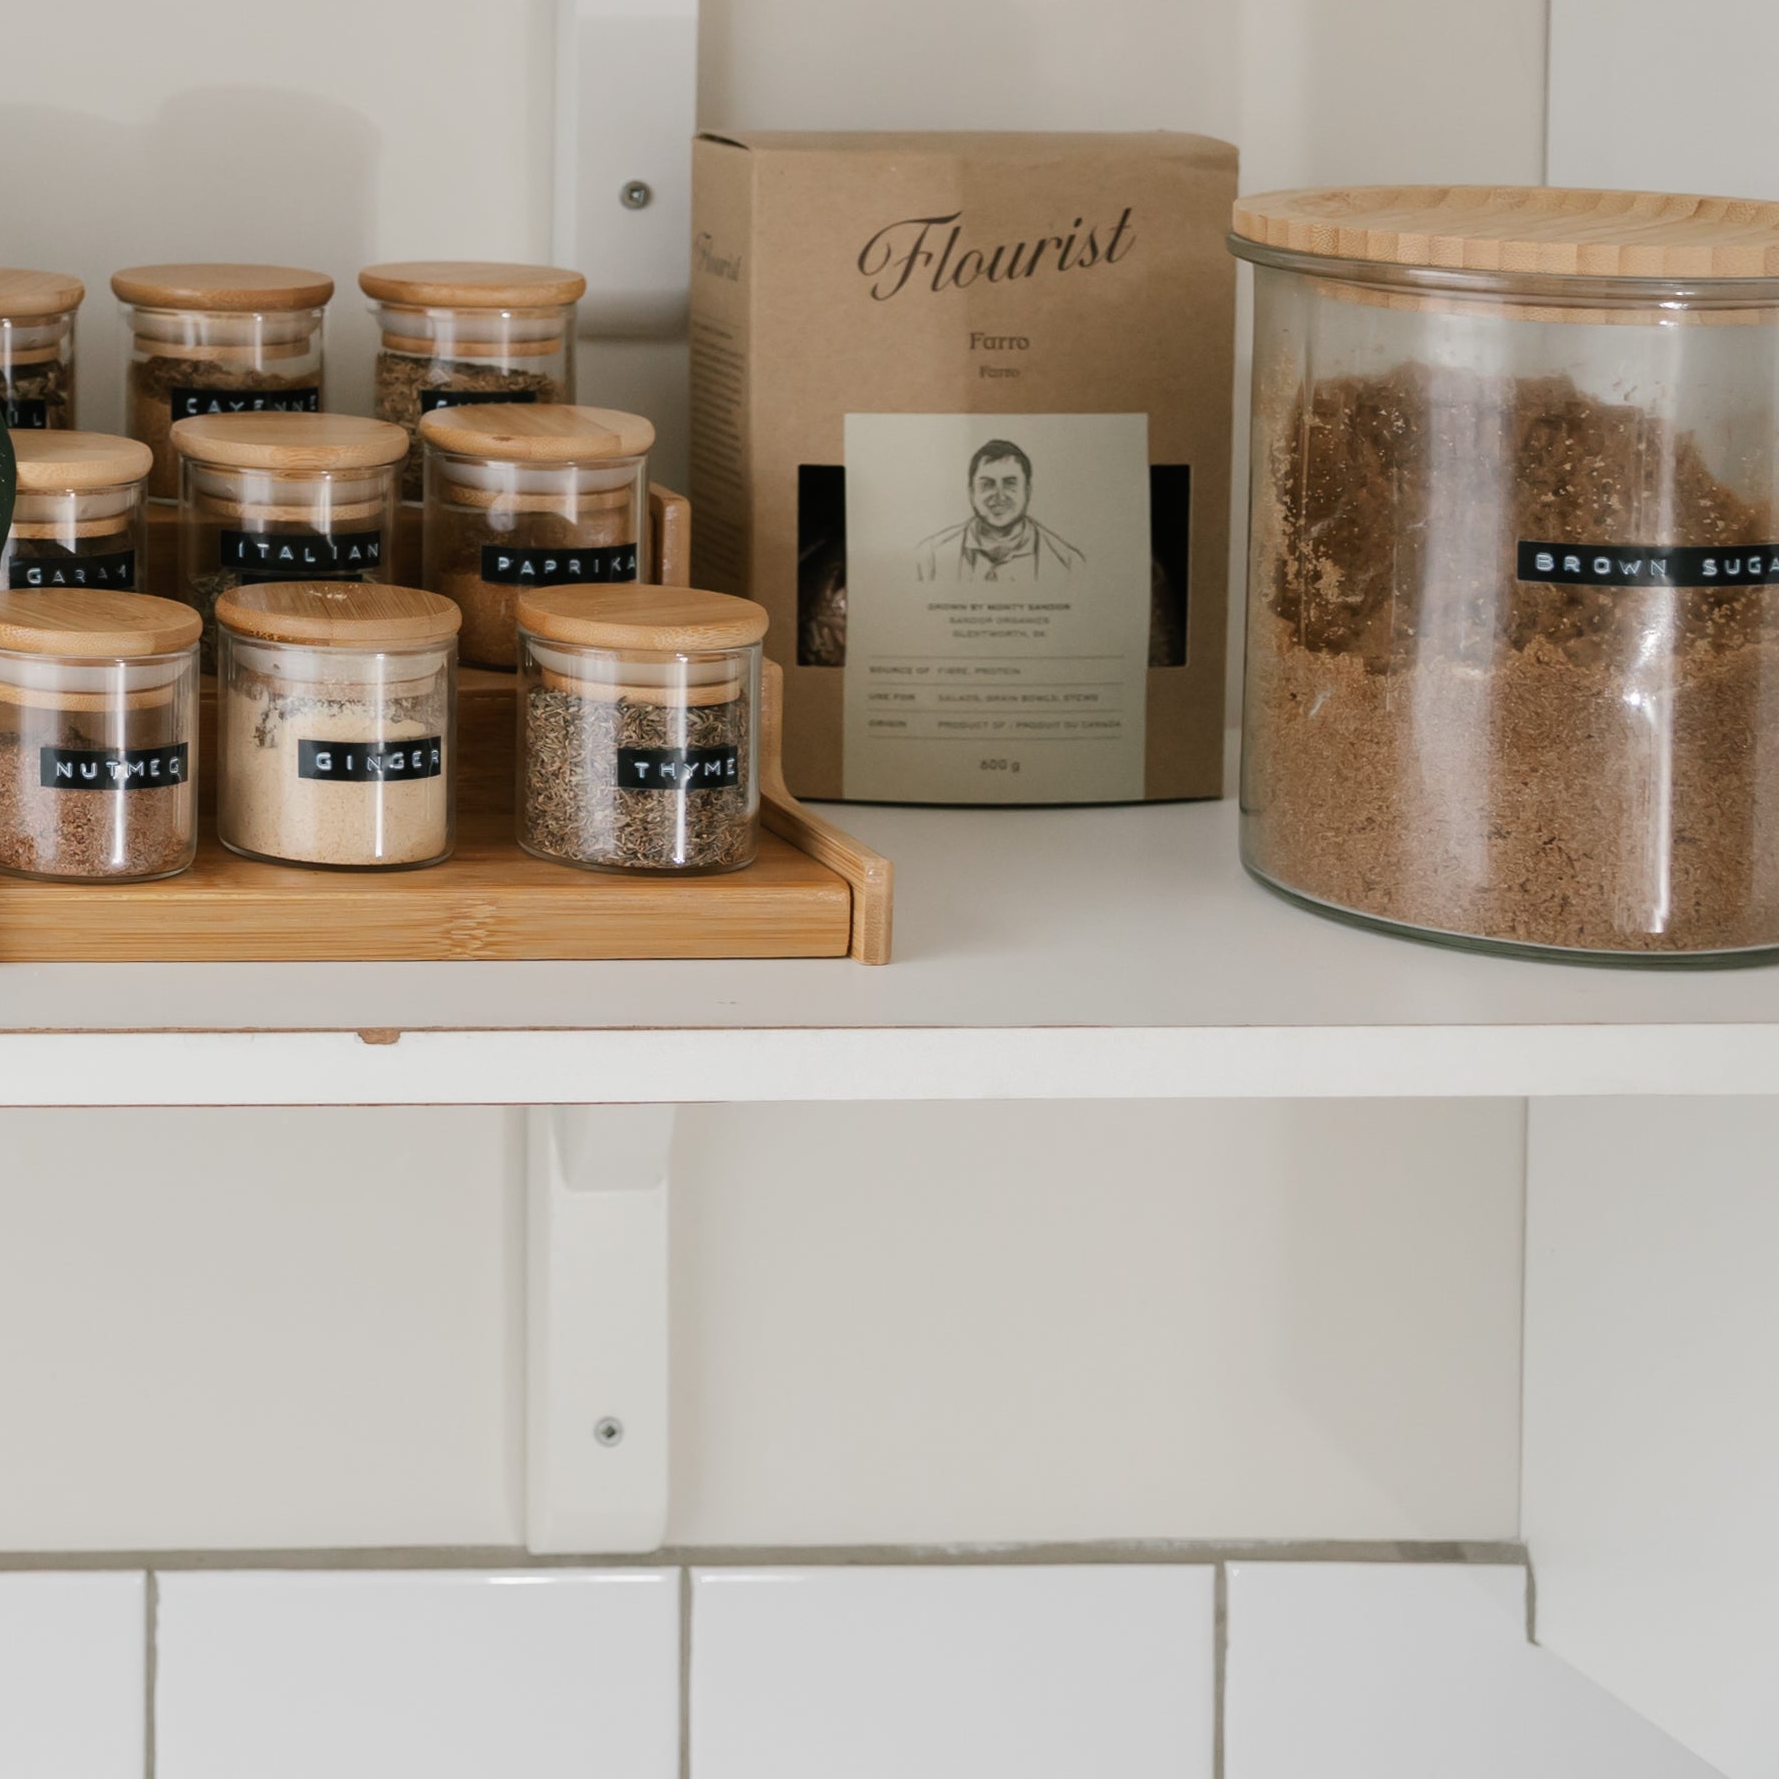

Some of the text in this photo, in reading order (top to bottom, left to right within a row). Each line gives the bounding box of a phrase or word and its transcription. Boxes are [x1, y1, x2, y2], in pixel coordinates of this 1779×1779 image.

[857, 207, 1137, 301] Flourist
[969, 332, 1030, 351] Farro
[237, 541, 380, 563] ITALIAN
[26, 563, 127, 585] GARAM
[497, 556, 636, 576] PAPRIKA
[1534, 552, 1779, 578] BROWN SUGA
[55, 757, 180, 781] NUTMEG
[315, 748, 441, 774] GINGER
[633, 757, 736, 780] THYME
